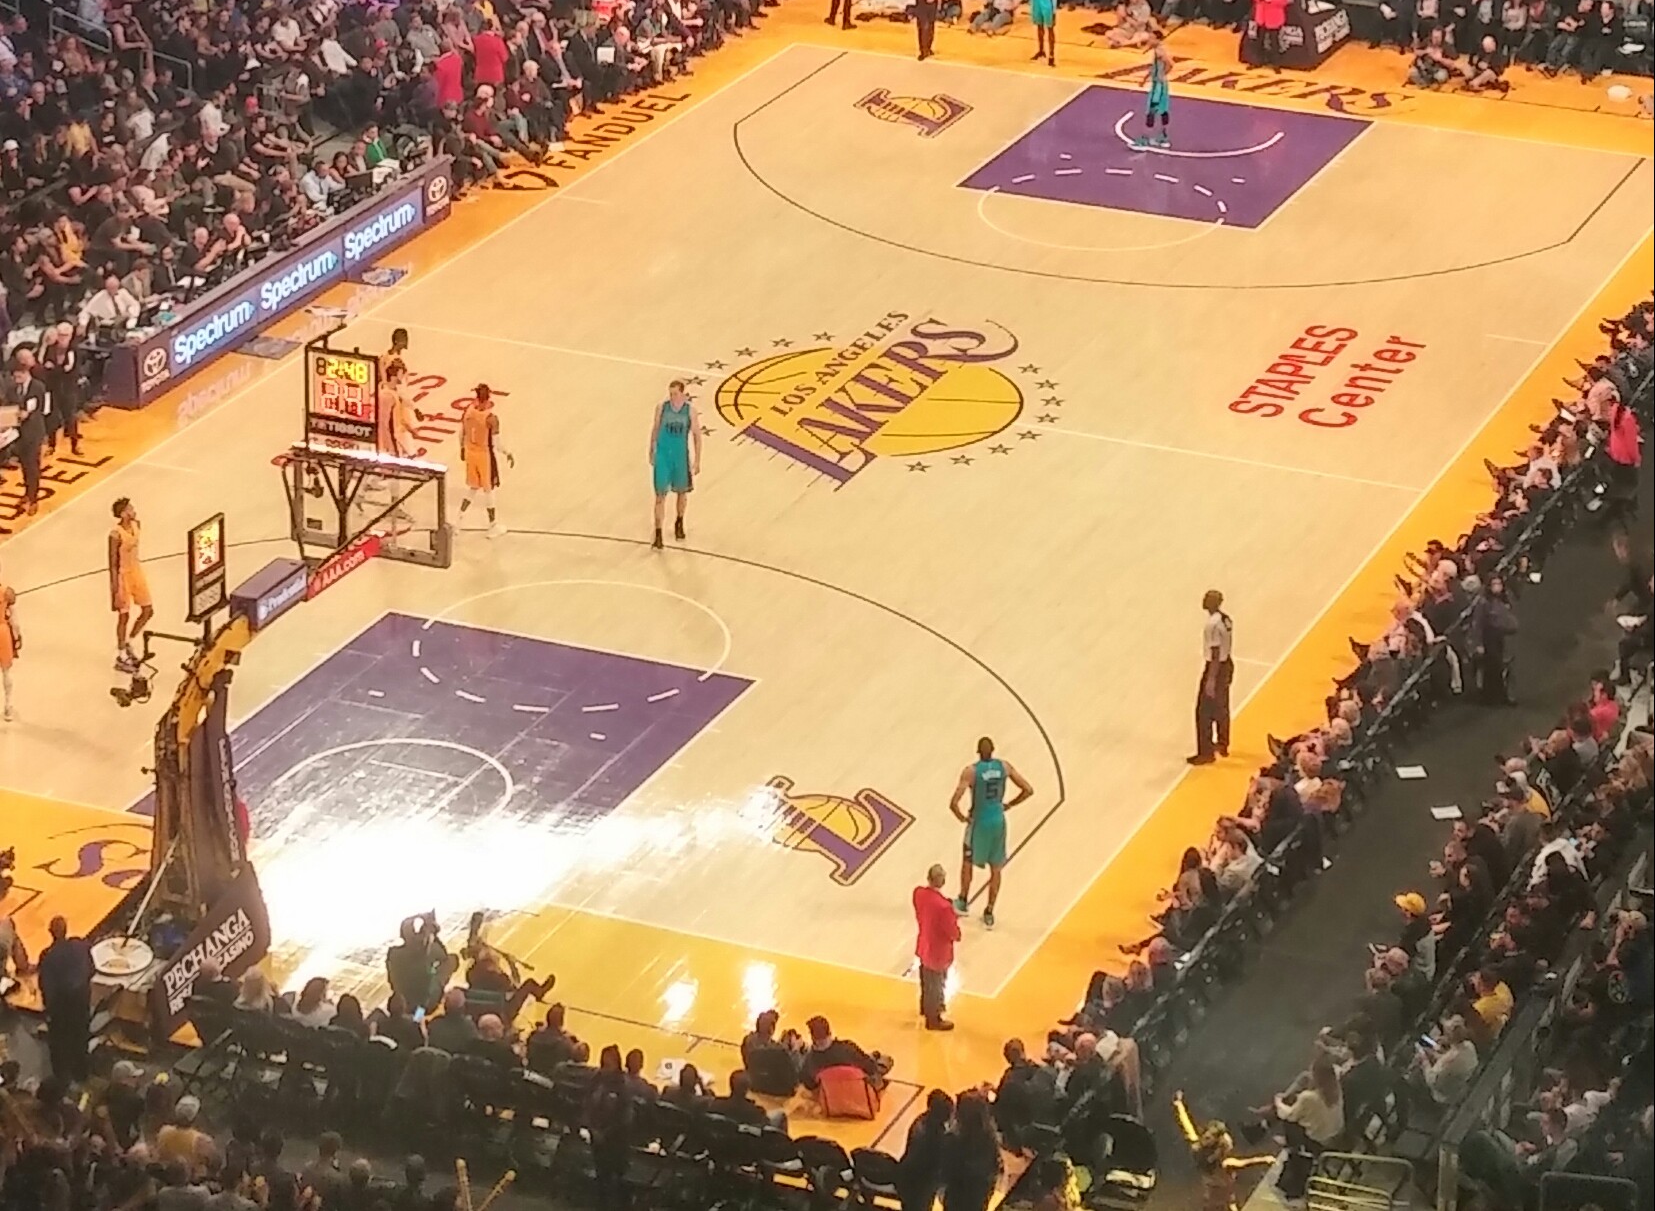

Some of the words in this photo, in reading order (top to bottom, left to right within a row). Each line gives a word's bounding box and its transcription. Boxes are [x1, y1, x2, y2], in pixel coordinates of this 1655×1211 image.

[542, 93, 692, 170] FANDUEL
[343, 201, 412, 261] Spectrum
[260, 250, 332, 311] Spectrum
[174, 300, 250, 365] Spectrum
[770, 383, 818, 417] LOS
[815, 310, 911, 386] ANGELES
[1228, 325, 1358, 417] STAPLES
[729, 316, 1019, 492] LAKERS
[1298, 335, 1427, 428] Center
[321, 549, 366, 588] AAA.com
[162, 906, 252, 997] PECHANGA
